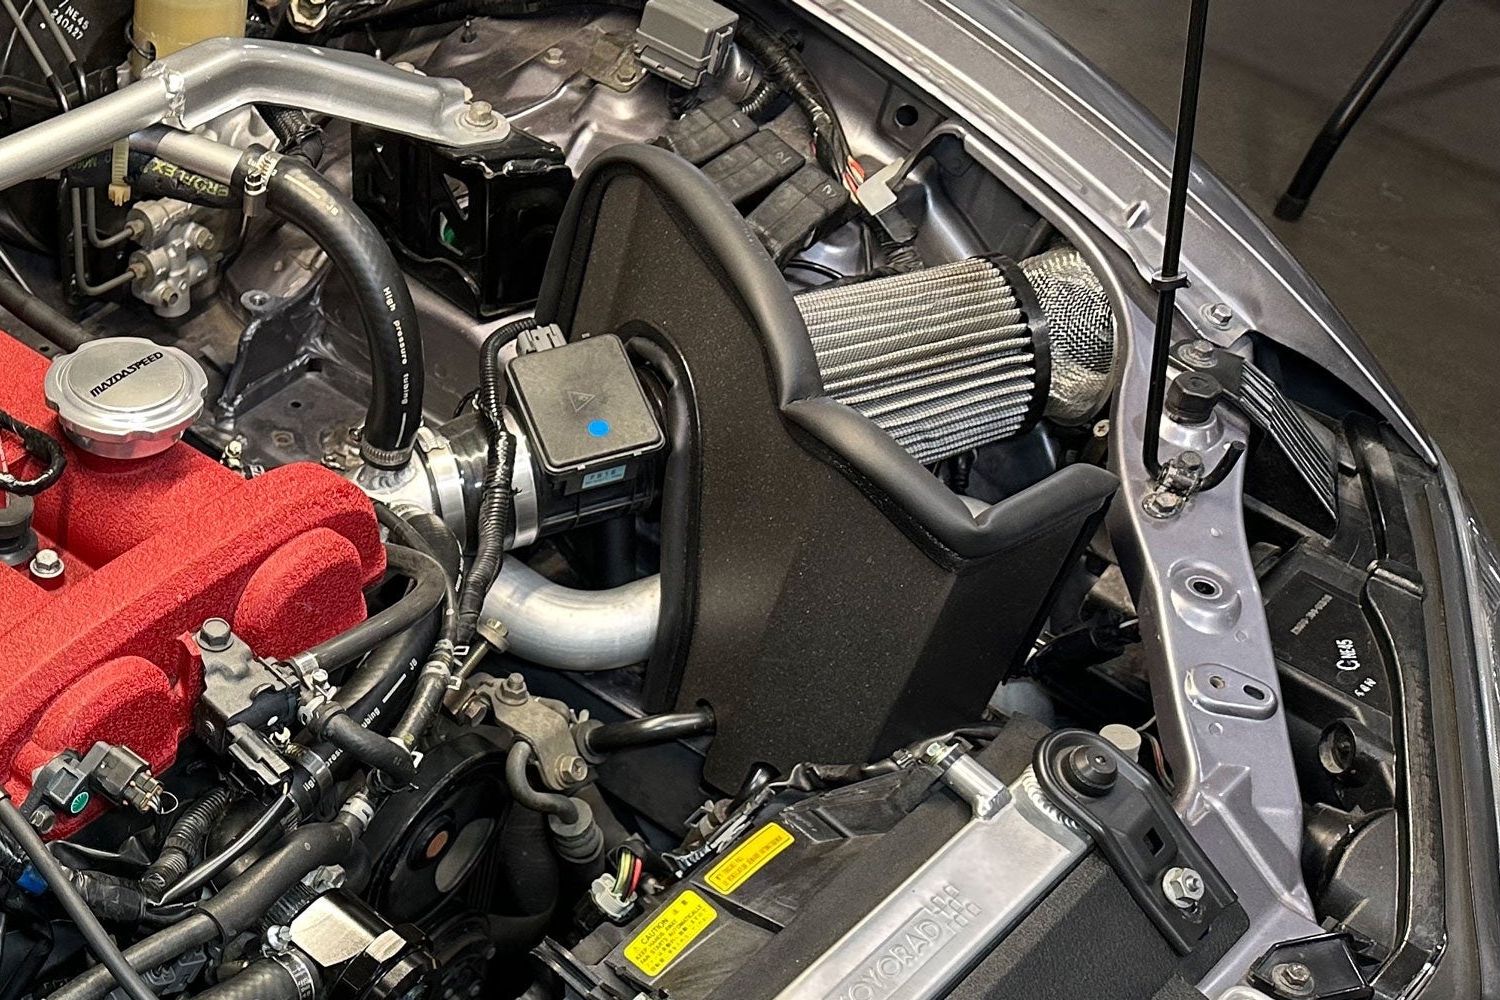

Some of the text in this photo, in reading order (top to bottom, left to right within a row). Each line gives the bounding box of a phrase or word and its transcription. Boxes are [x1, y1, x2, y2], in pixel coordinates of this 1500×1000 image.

[393, 319, 408, 365] pressure
[90, 351, 165, 398] MAZDASPEED
[400, 373, 410, 405] tubing
[640, 918, 669, 945] CAUTION
